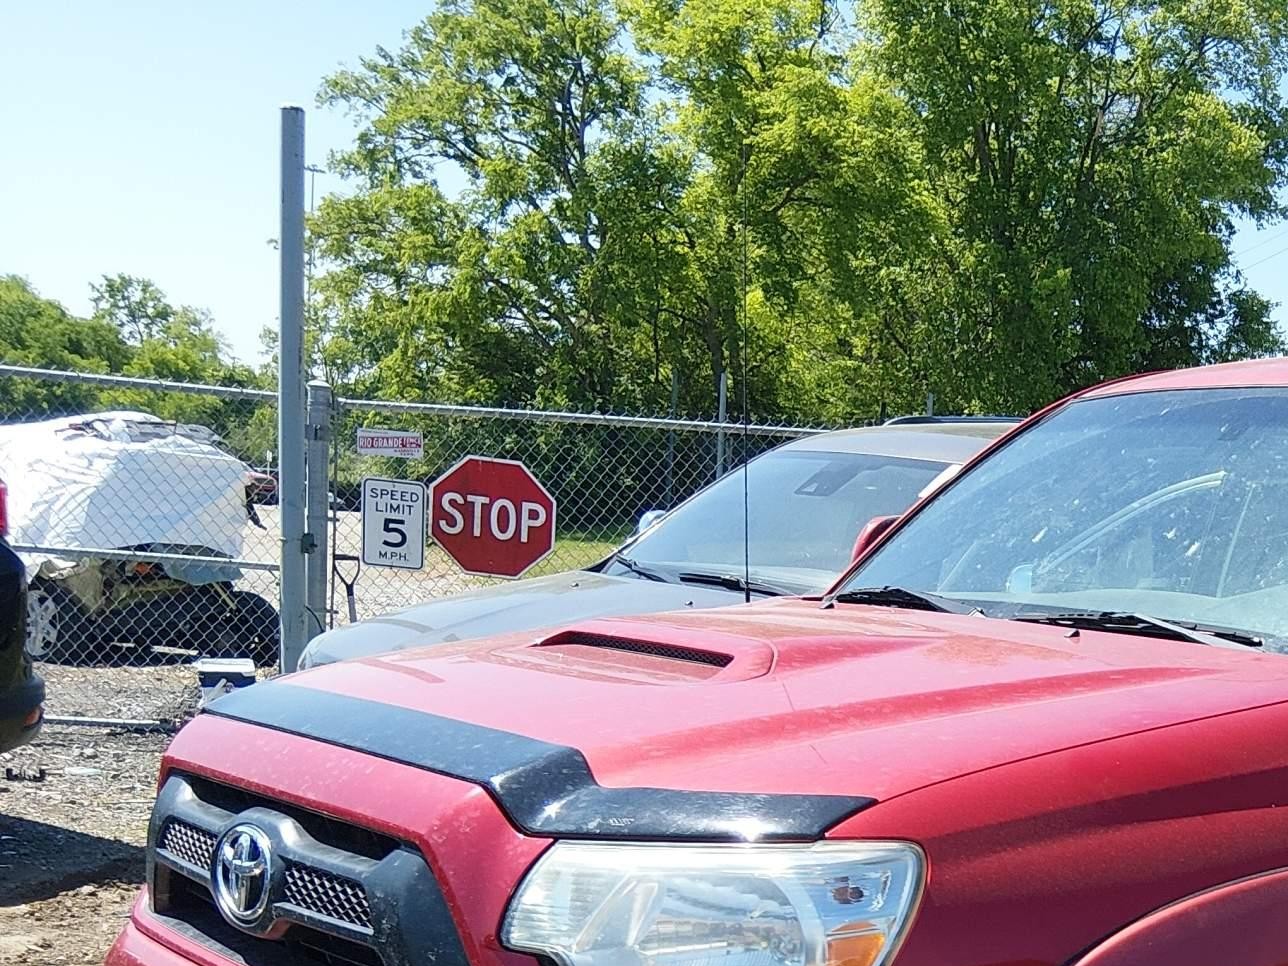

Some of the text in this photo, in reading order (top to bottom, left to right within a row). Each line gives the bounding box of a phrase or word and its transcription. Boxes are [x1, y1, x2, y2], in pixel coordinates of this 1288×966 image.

[359, 436, 372, 448] RIO
[372, 436, 402, 448] GRANDE
[369, 487, 420, 503] SPEED
[375, 501, 414, 516] LIMIT
[438, 491, 547, 543] STOP
[382, 517, 408, 548] 5
[378, 550, 409, 562] M.P.H.
